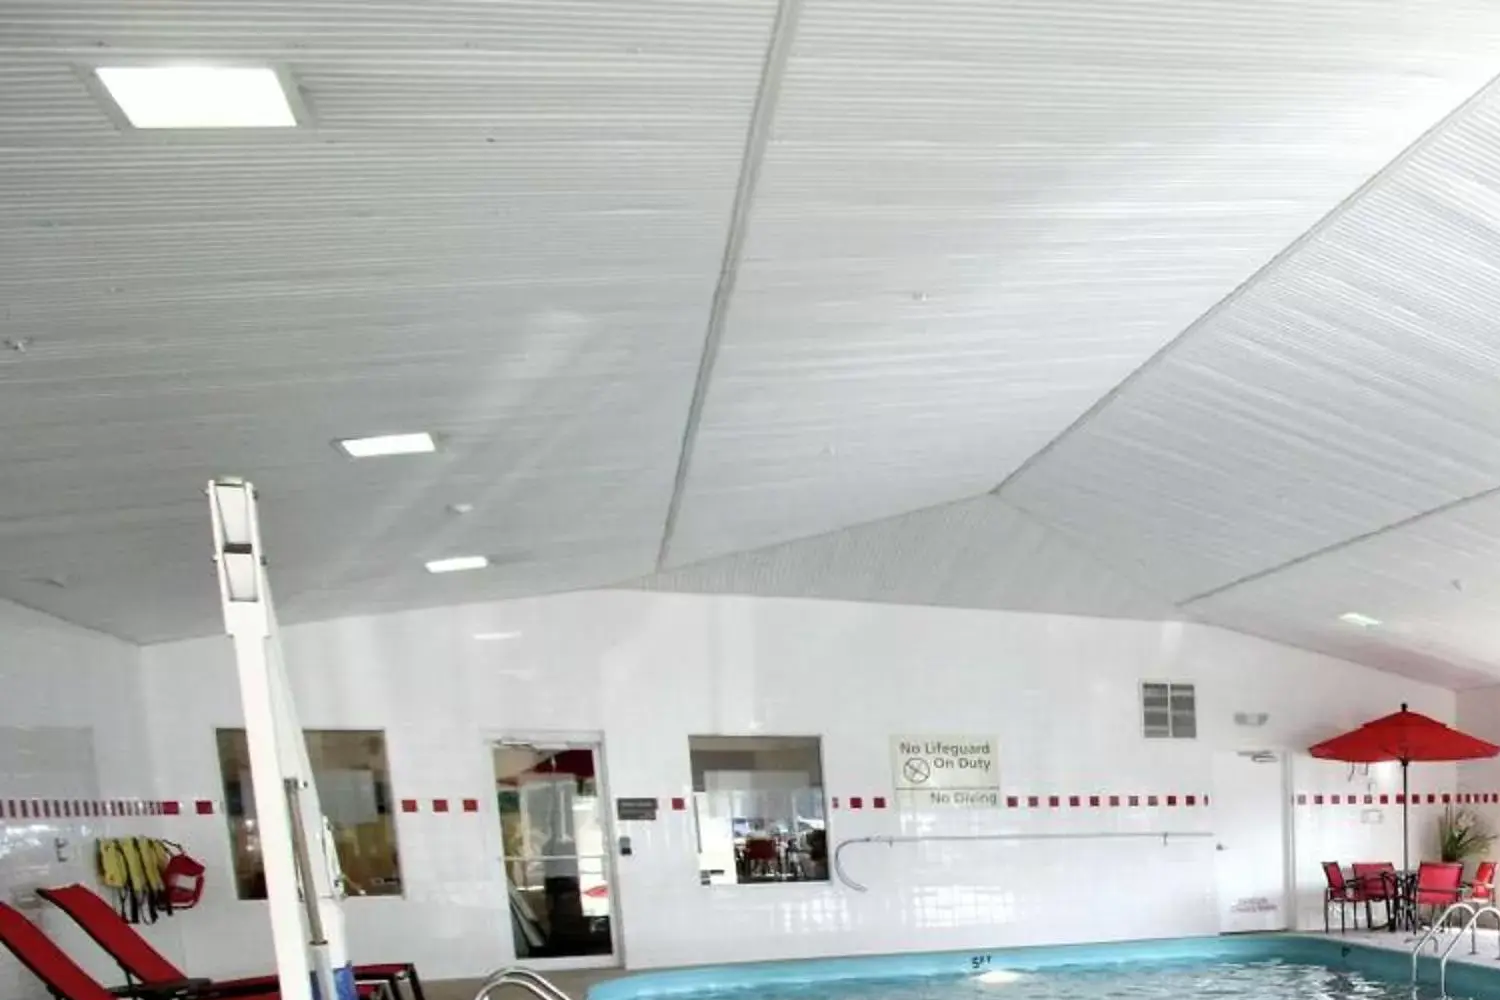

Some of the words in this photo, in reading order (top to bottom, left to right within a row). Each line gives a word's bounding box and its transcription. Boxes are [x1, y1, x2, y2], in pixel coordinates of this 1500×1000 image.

[899, 742, 921, 754] No
[925, 740, 991, 757] Lifeguard
[933, 757, 954, 769] On
[959, 757, 991, 773] Duty
[930, 793, 950, 804] No
[953, 792, 997, 805] Diving
